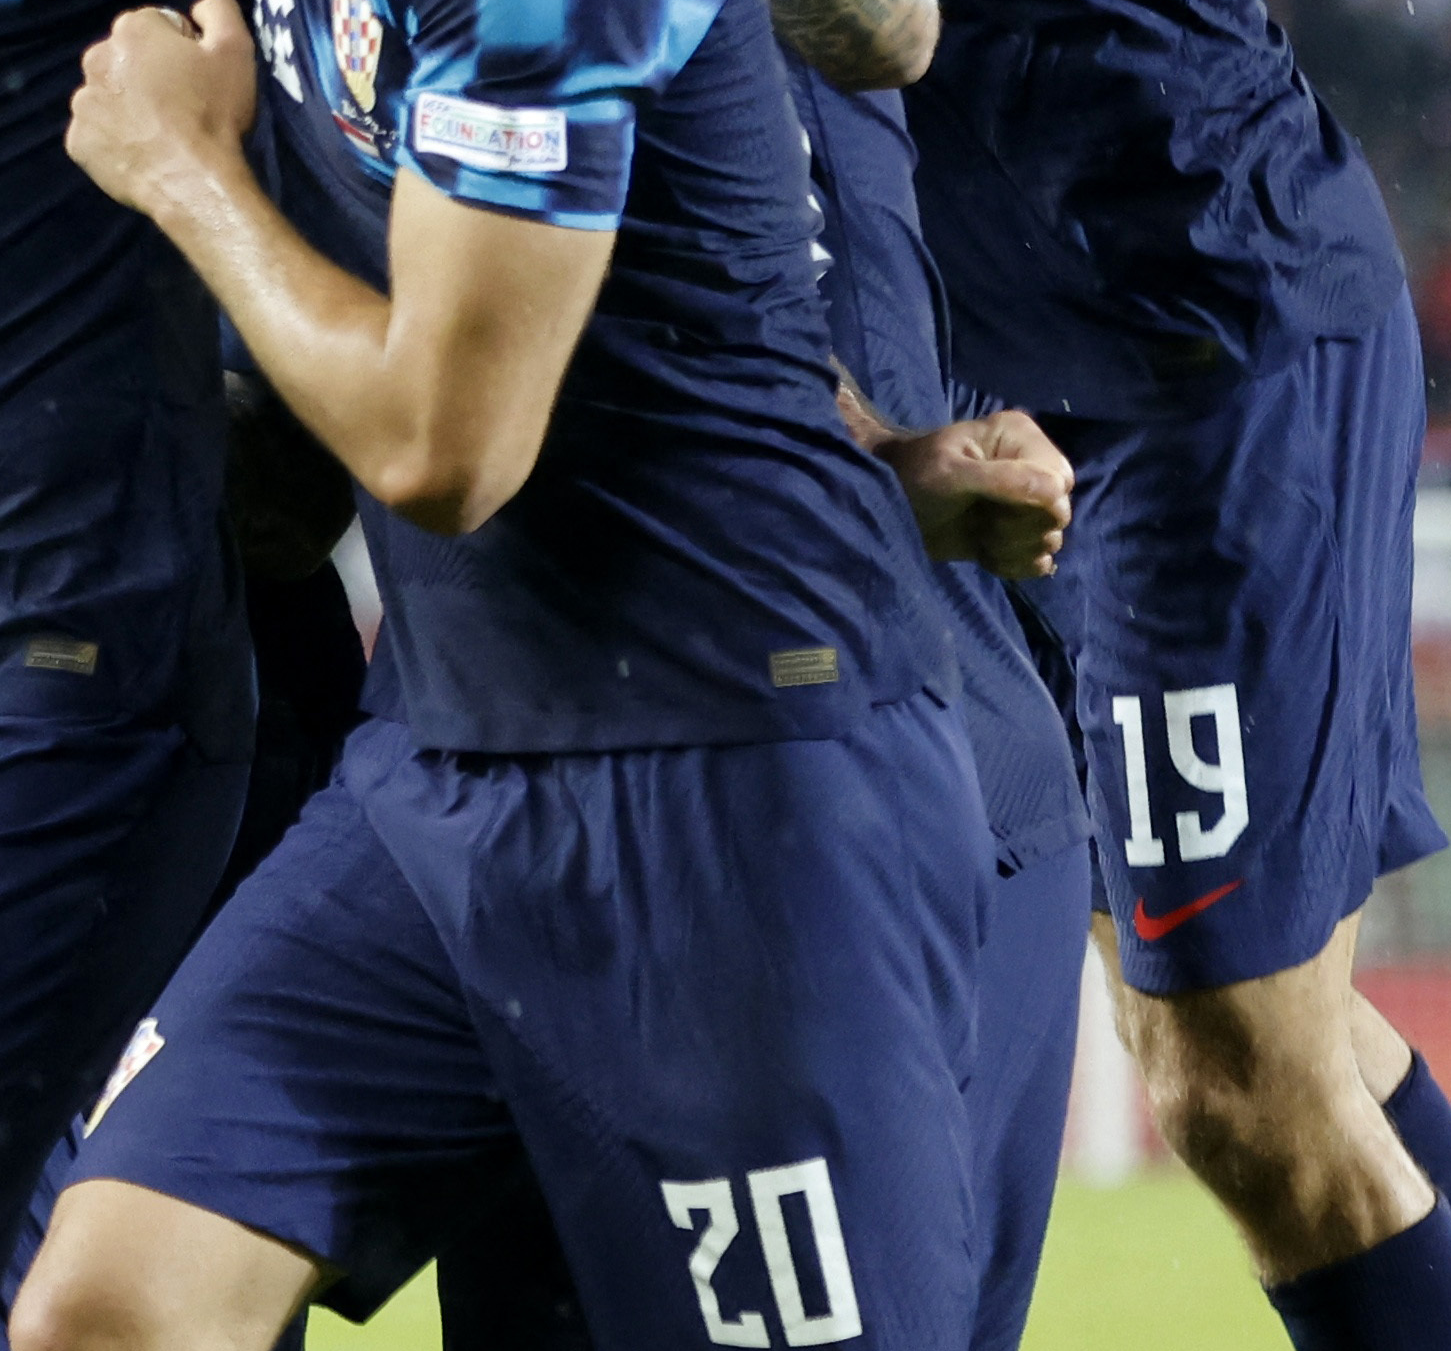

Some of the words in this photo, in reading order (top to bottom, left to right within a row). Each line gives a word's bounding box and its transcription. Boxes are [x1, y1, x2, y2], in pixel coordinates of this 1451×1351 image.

[420, 113, 560, 150] FOUNDATION
[1112, 683, 1249, 867] 19
[659, 1156, 863, 1349] 20
